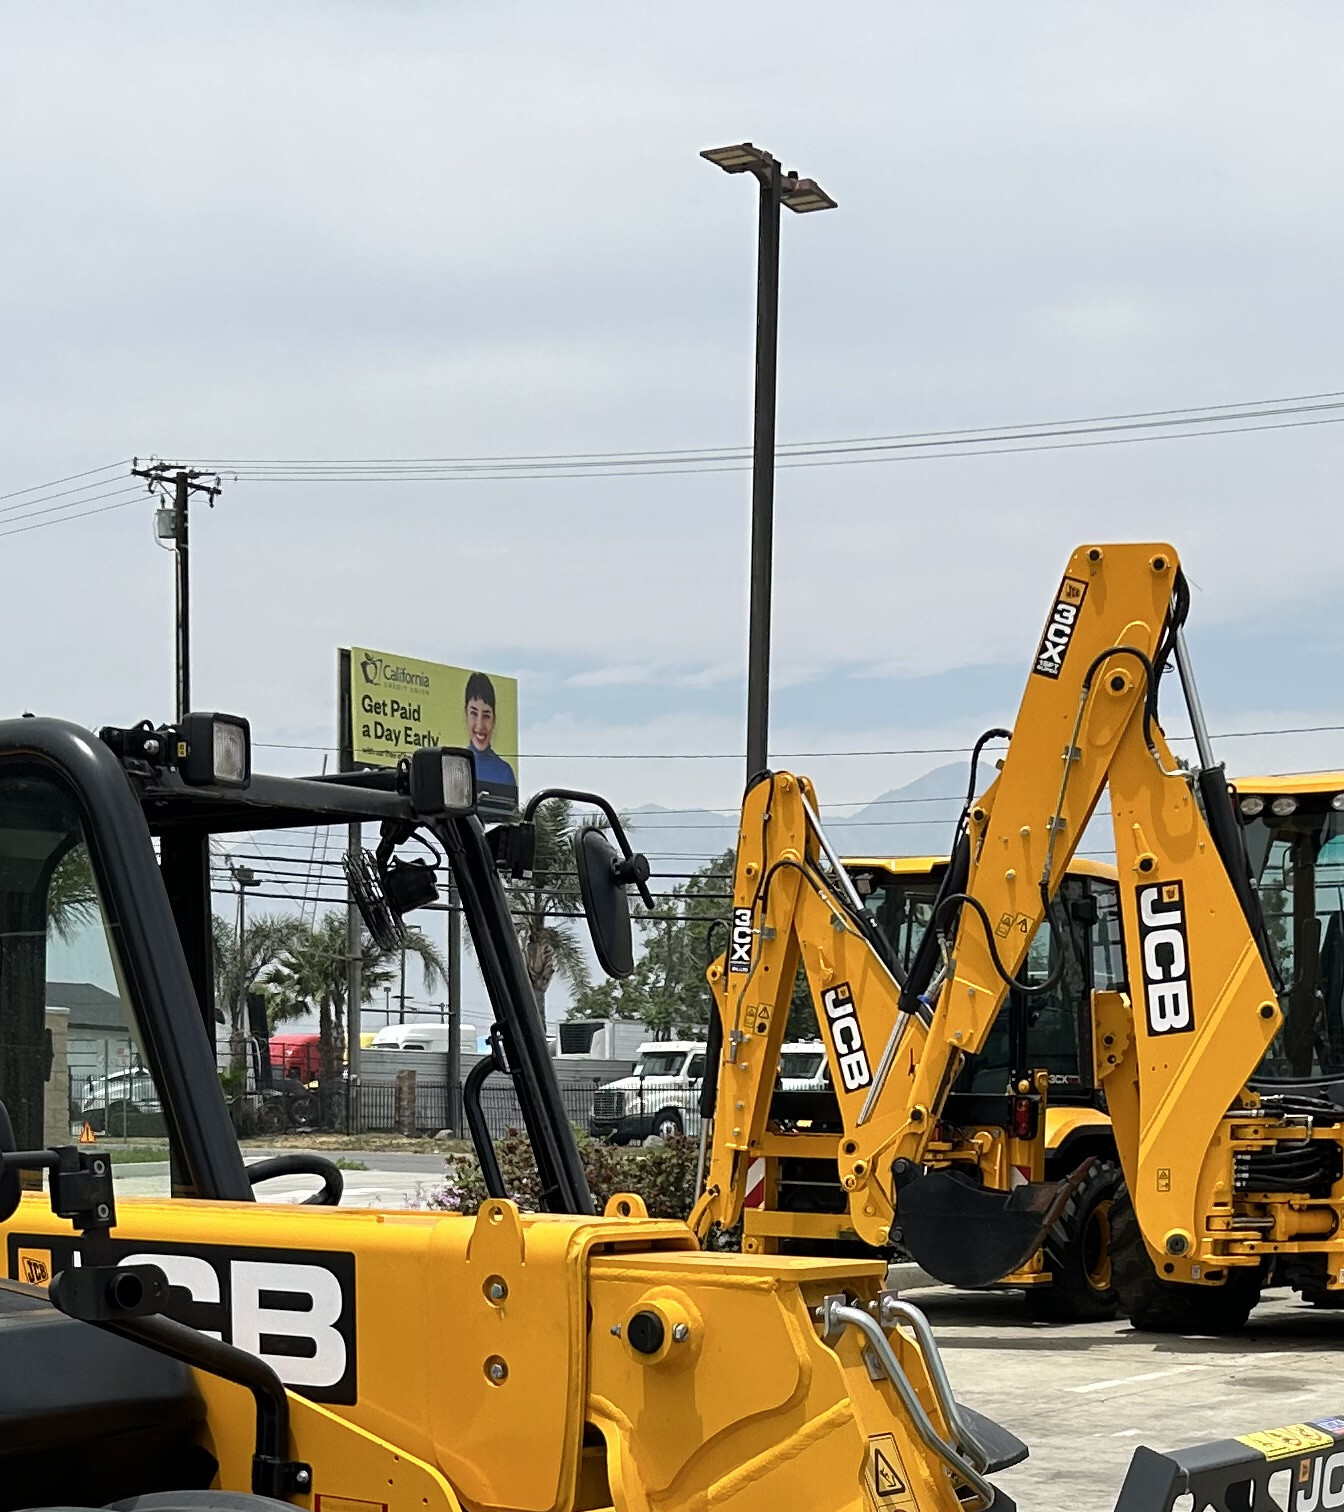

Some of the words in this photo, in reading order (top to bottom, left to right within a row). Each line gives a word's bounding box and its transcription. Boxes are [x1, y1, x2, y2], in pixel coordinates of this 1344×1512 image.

[1039, 603, 1077, 664] 3CX
[383, 664, 430, 688] California
[362, 694, 388, 716] Get
[391, 700, 421, 722] Paid
[362, 723, 371, 738] a
[374, 721, 401, 747] Day
[405, 726, 440, 748] Early
[732, 909, 751, 960] 3CX
[1141, 887, 1189, 1032] JCB
[825, 990, 870, 1090] JCB
[1048, 1075, 1068, 1084] 3CX
[27, 1260, 46, 1283] JCB
